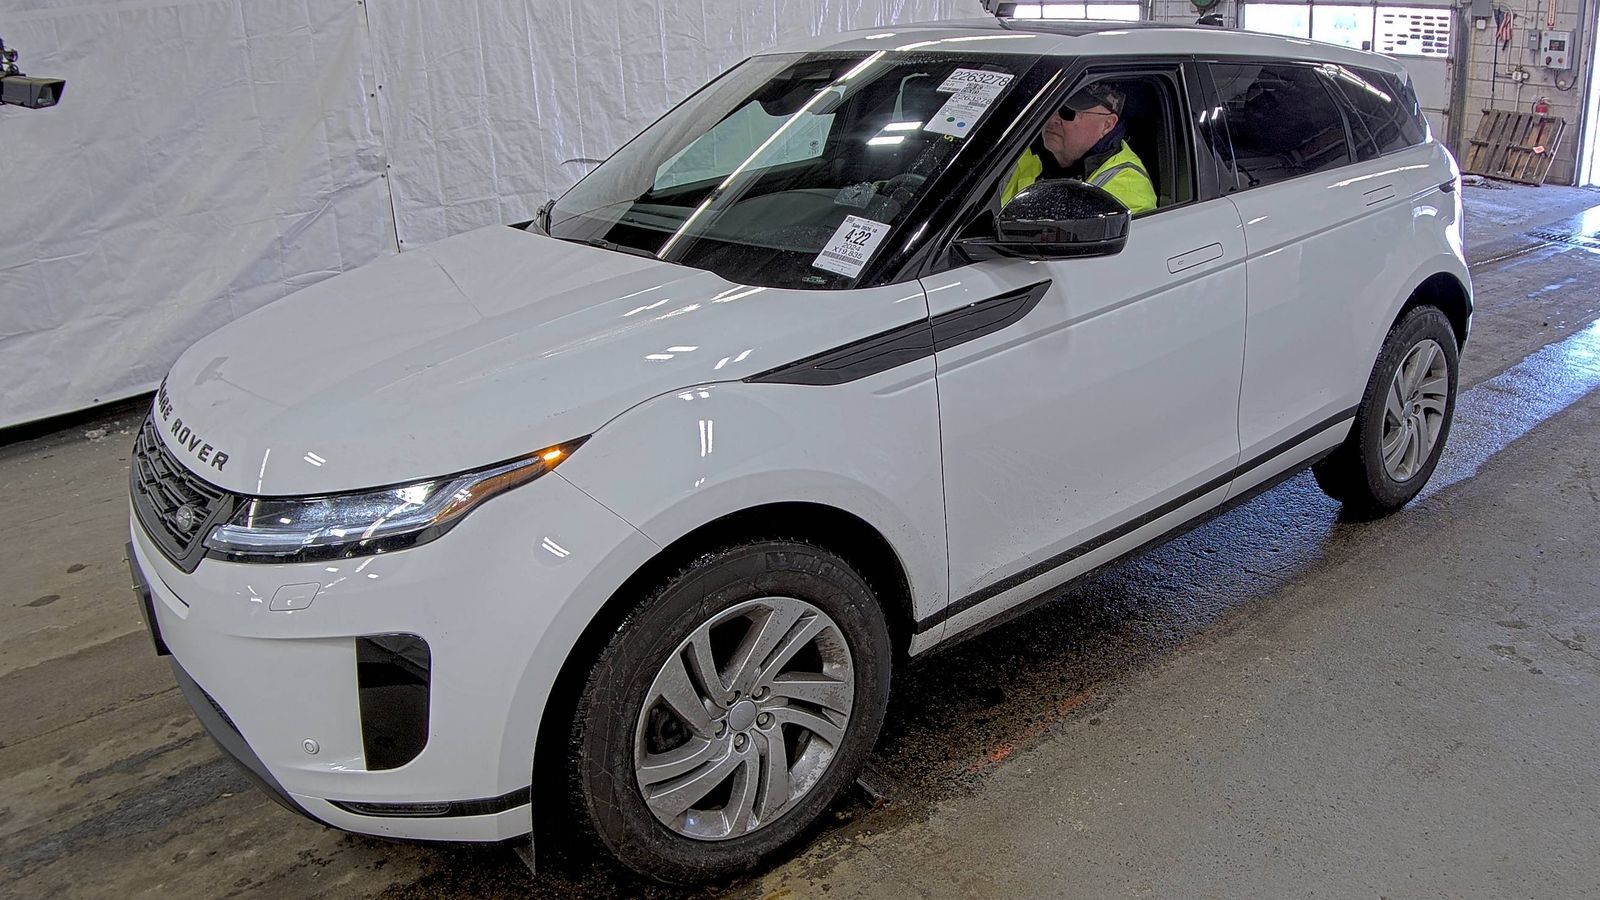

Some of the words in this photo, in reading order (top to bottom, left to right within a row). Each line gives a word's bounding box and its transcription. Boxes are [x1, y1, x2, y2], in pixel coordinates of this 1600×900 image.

[950, 71, 1010, 87] 2263278
[844, 229, 872, 246] 4:22
[841, 242, 861, 252] 2024
[171, 418, 229, 471] ROVER
